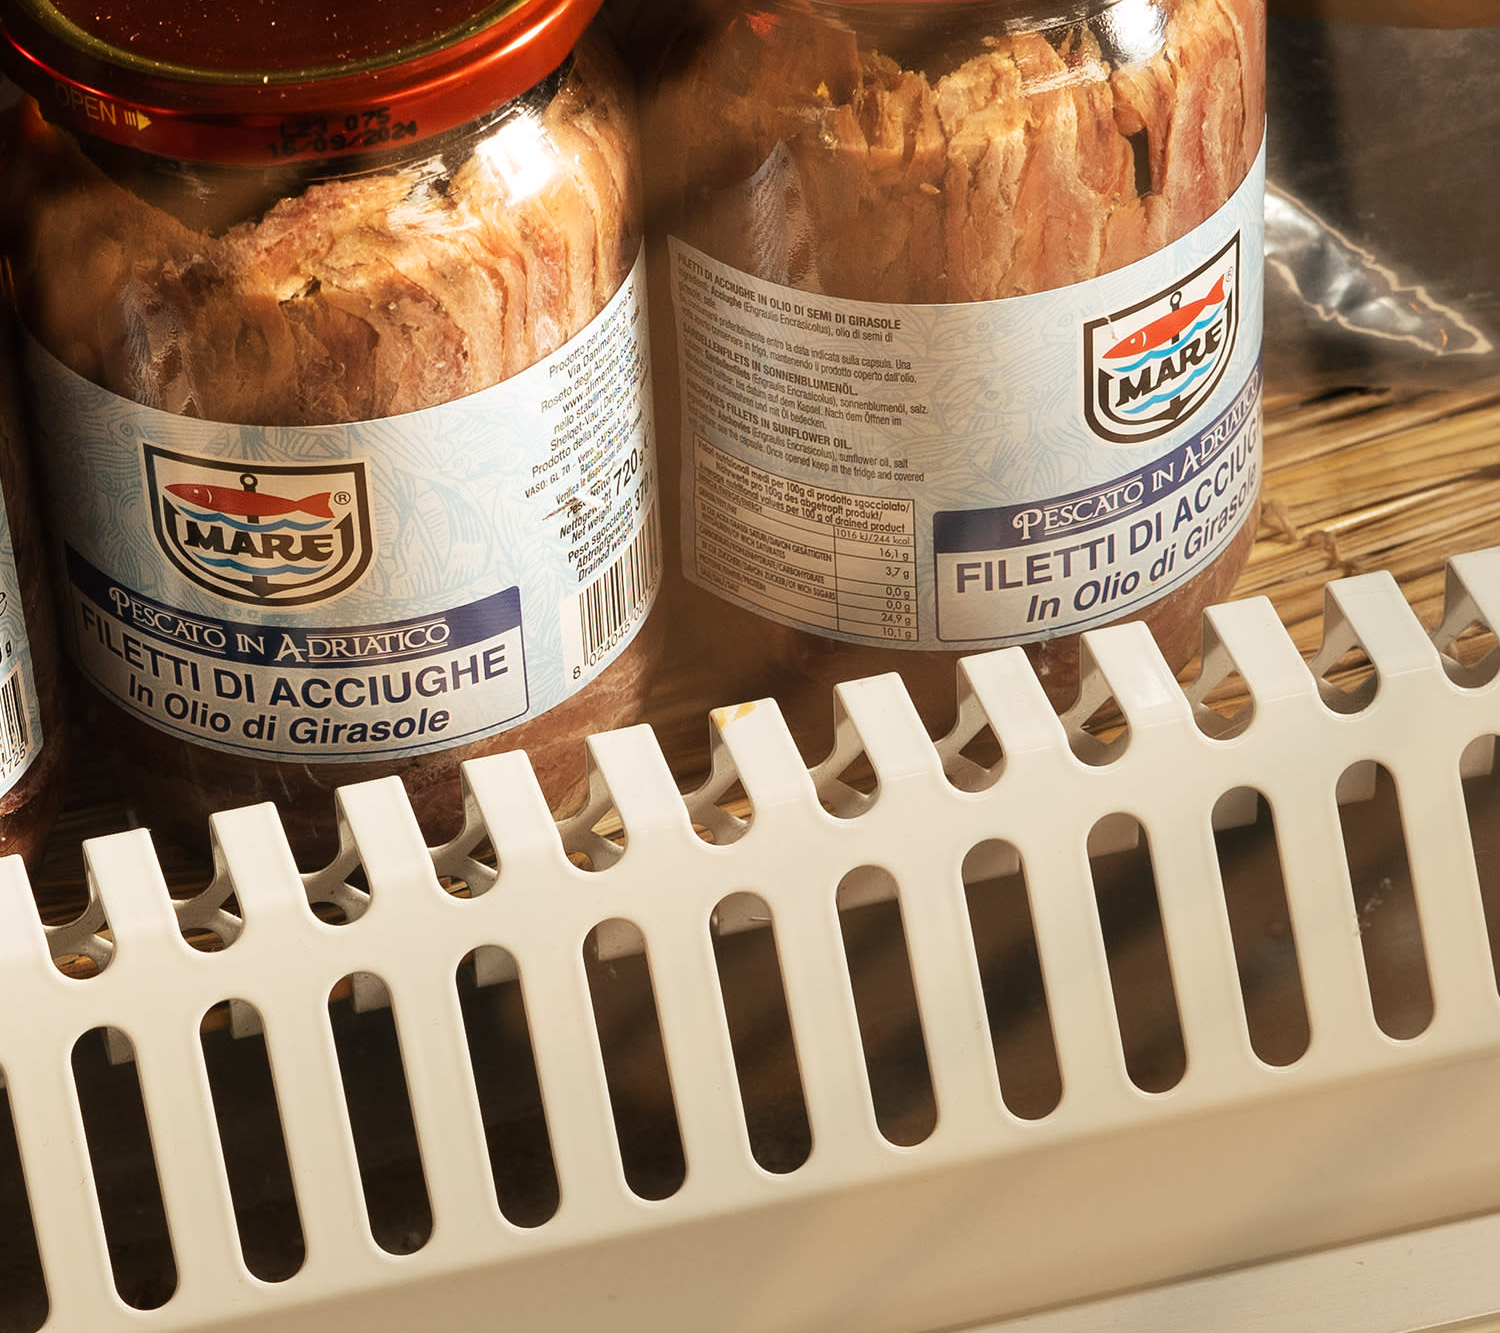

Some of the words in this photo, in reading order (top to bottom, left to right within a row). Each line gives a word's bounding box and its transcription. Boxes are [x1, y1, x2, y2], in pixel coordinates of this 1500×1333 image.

[55, 82, 116, 126] OPEN
[345, 107, 391, 131] 075
[268, 120, 418, 158] 16/09/2024
[770, 298, 792, 314] OLIO
[807, 307, 833, 322] SEMI
[835, 313, 847, 324] DI
[848, 315, 901, 330] GIRASOLE
[549, 344, 586, 379] Prodotto
[1115, 318, 1223, 408] MARE
[772, 422, 832, 447] SUNFLOWER
[833, 436, 853, 450] OIL.
[614, 448, 638, 498] 720
[1151, 461, 1174, 492] IN
[816, 490, 853, 506] prodotto
[184, 521, 334, 563] MARE
[567, 541, 590, 563] Peso
[836, 528, 858, 541] 1016
[1026, 594, 1061, 623] In
[1073, 568, 1141, 612] Olio
[1149, 543, 1176, 583] di
[1183, 462, 1258, 561] Girasole
[879, 547, 899, 559] 16,1
[956, 533, 1116, 594] FILETTI
[1129, 511, 1163, 556] DI
[4, 640, 13, 659] g
[81, 608, 201, 692] FILETTI
[213, 667, 257, 705] DI
[268, 643, 509, 708] ACCIUGHE
[236, 633, 266, 656] IN
[572, 665, 582, 680] 8
[589, 619, 631, 667] 024045
[128, 673, 155, 709] In
[164, 691, 232, 735] Olio
[242, 712, 278, 743] di
[288, 706, 451, 747] Girasole
